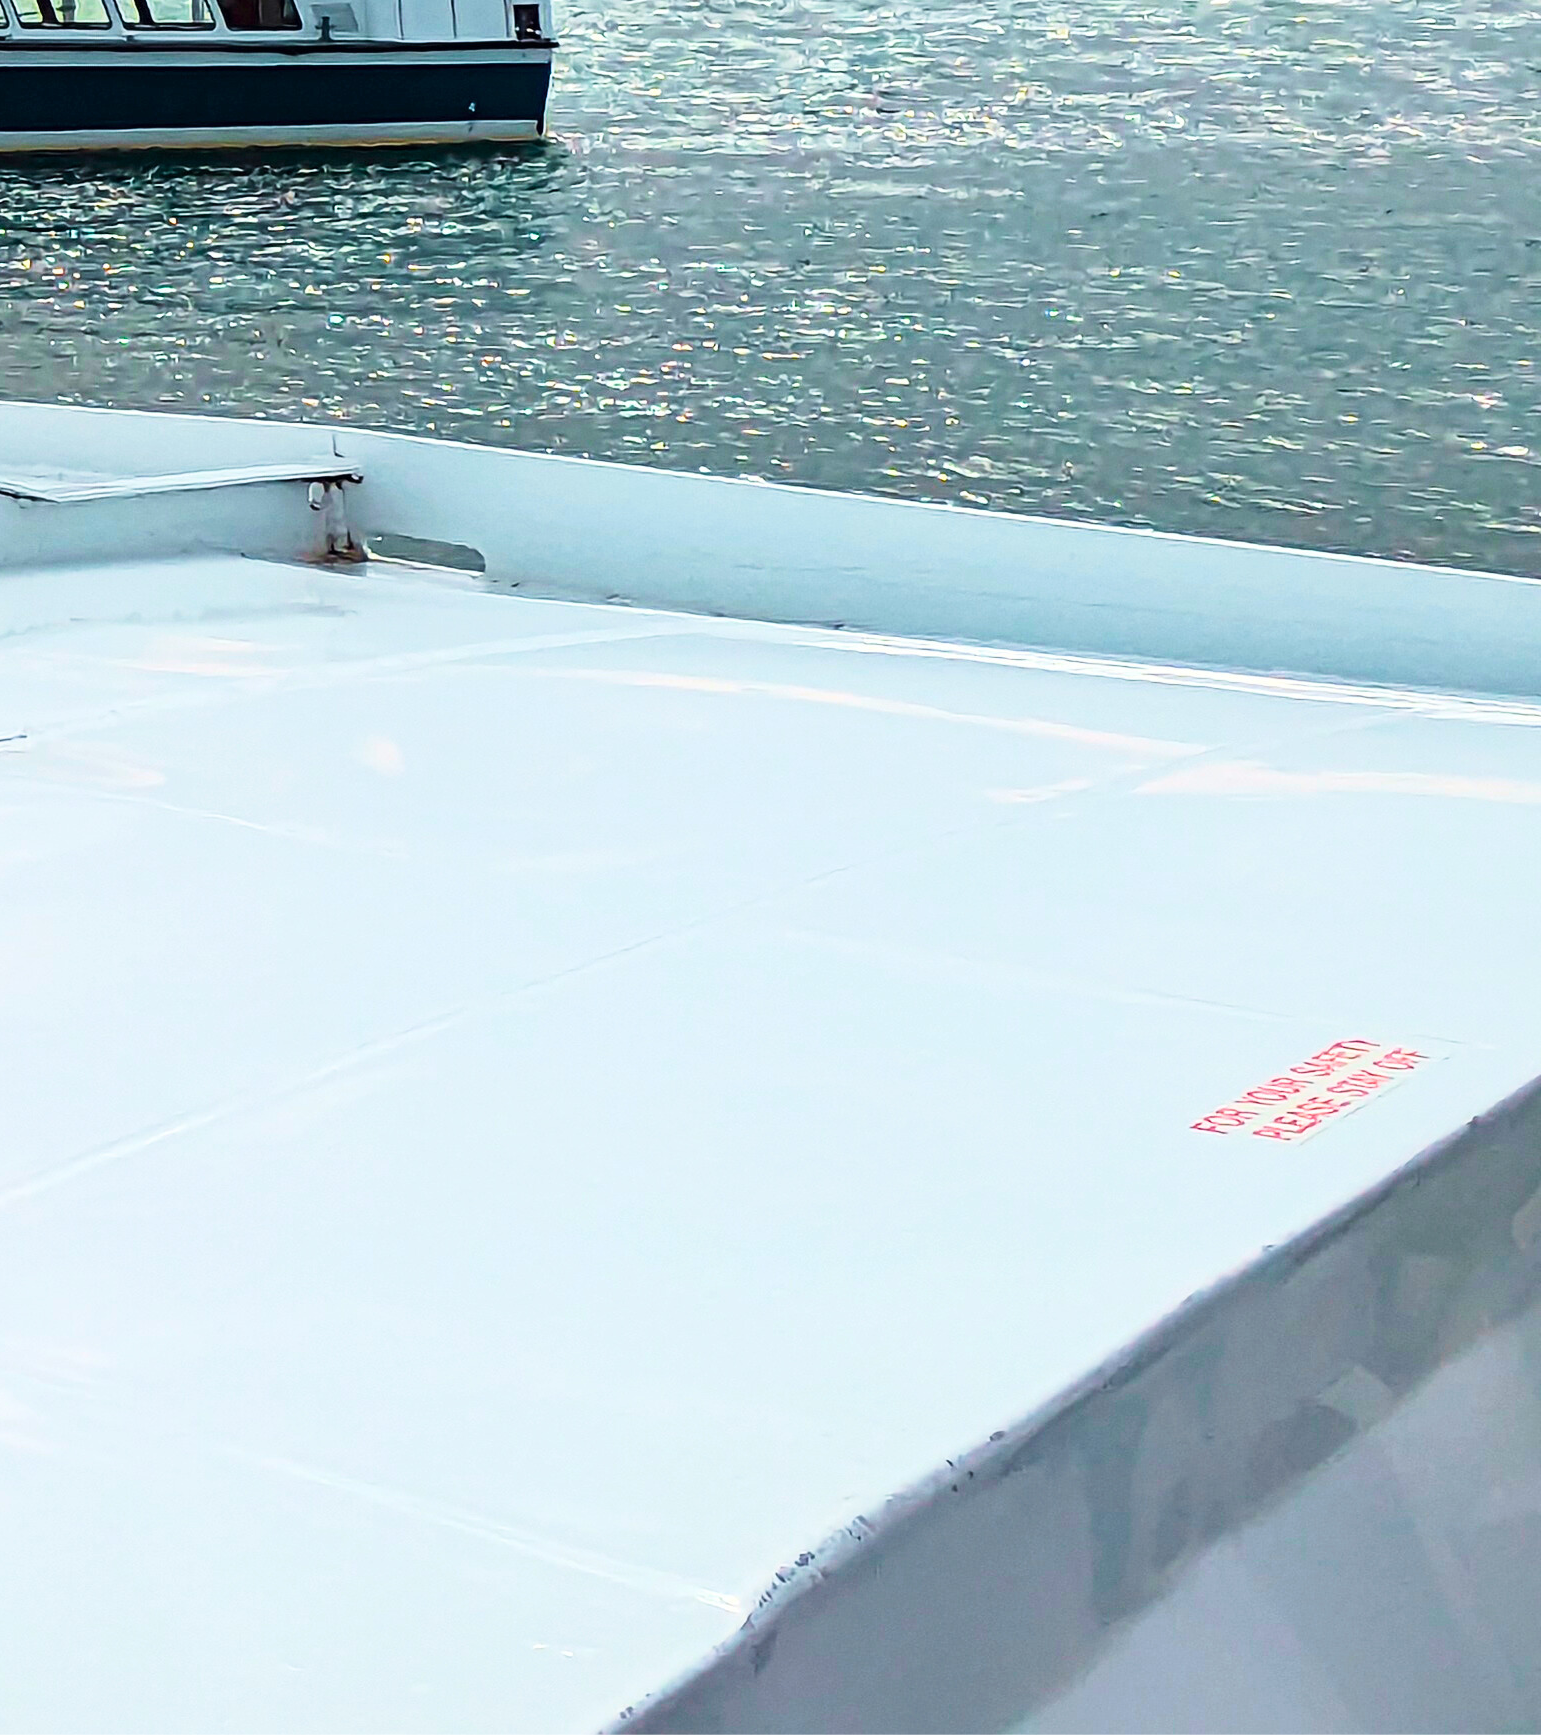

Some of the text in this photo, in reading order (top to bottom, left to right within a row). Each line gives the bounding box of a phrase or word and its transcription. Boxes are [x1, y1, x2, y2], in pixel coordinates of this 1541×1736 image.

[1190, 1040, 1380, 1134] FOR YOUR SAFETY
[1253, 1048, 1430, 1140] PLEASE STAY OFF
